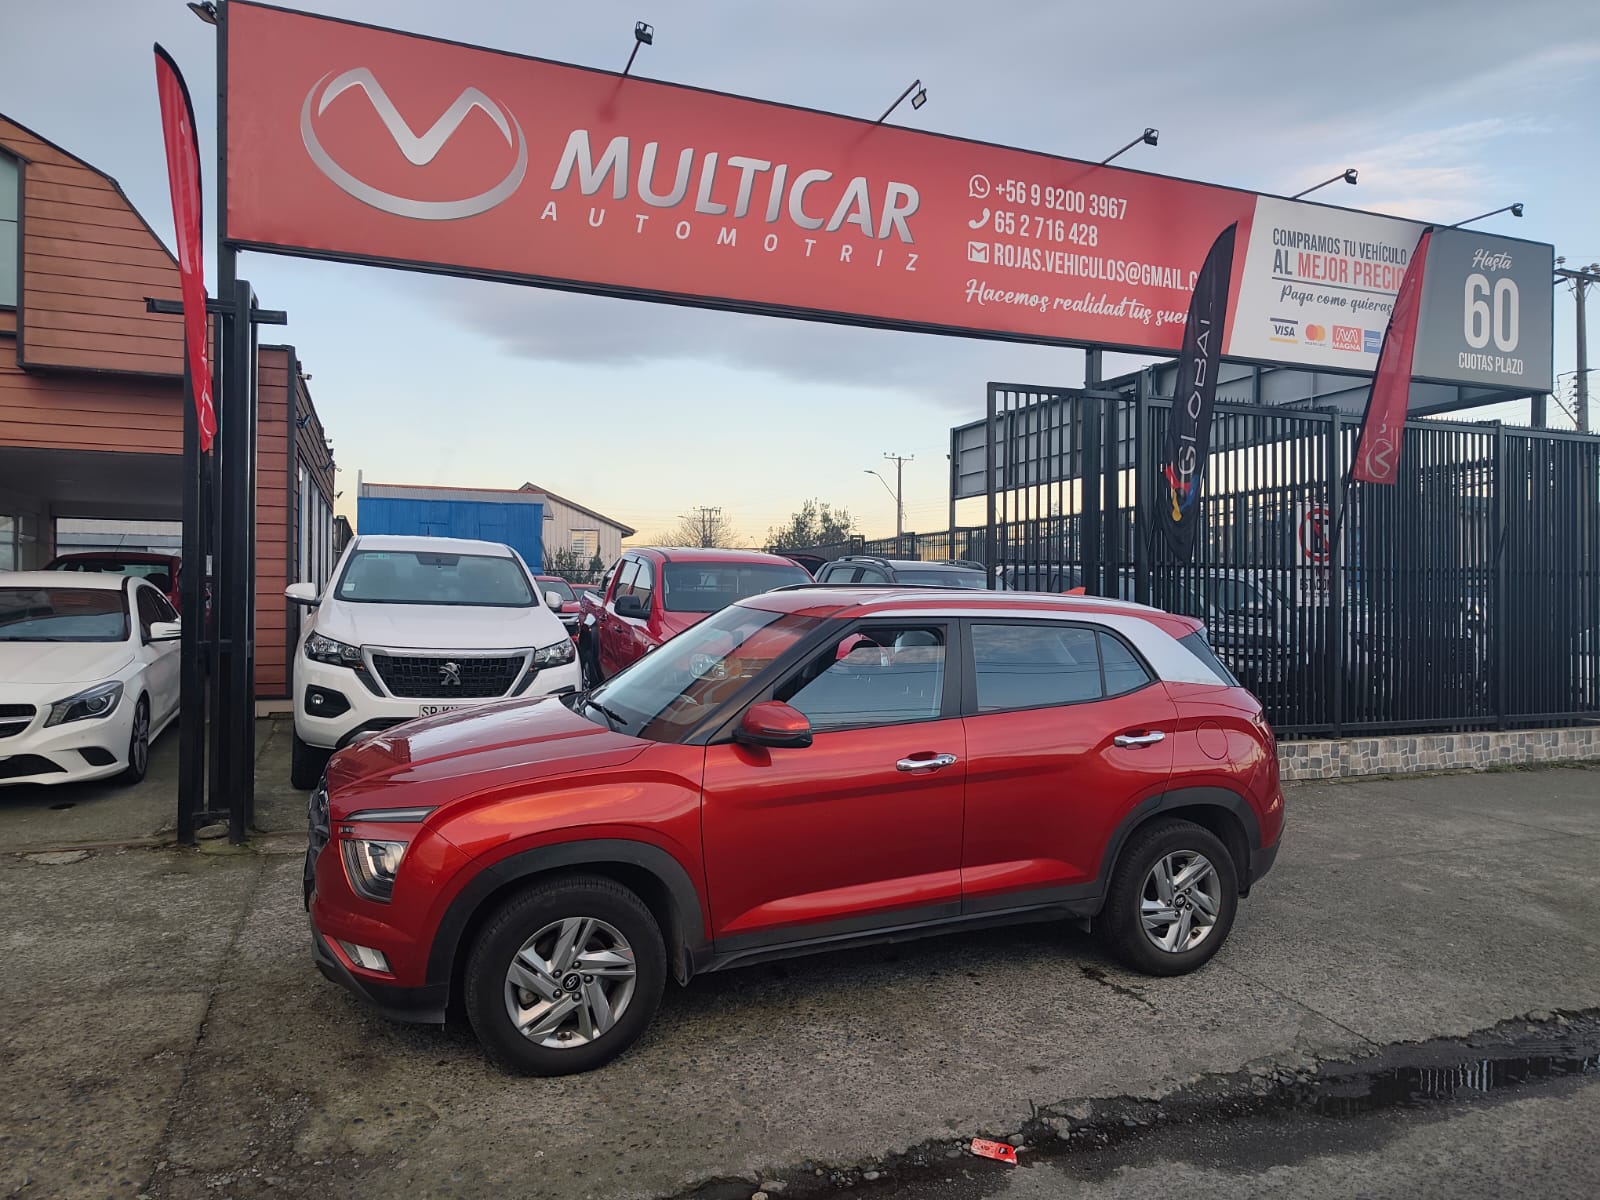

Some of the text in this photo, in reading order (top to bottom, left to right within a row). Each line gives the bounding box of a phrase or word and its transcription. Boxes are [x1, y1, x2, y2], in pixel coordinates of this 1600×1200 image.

[550, 129, 921, 244] MULTICAR
[996, 179, 1128, 220] +56 9 9200 3967
[541, 201, 919, 271] AUTOMOTRIZ
[994, 211, 1098, 247] 65 2 716 428
[1272, 228, 1407, 265] COMPRAMOS TU VEHÍCULO
[994, 243, 1198, 291] ROJAS.VEHICULOS@GMAIL.C
[1273, 248, 1293, 275] AL
[1297, 252, 1348, 283] MEJOR
[1472, 248, 1512, 272] Hasta
[965, 278, 1050, 313] Hacemos
[1053, 292, 1126, 317] realidad
[1121, 298, 1152, 326] tus
[1280, 284, 1314, 307] Paga
[1316, 293, 1348, 307] como
[1464, 273, 1519, 352] 60
[1273, 324, 1296, 337] VISA
[1332, 341, 1361, 351] MAGNA
[1458, 352, 1524, 375] CUOTAS PLAZO
